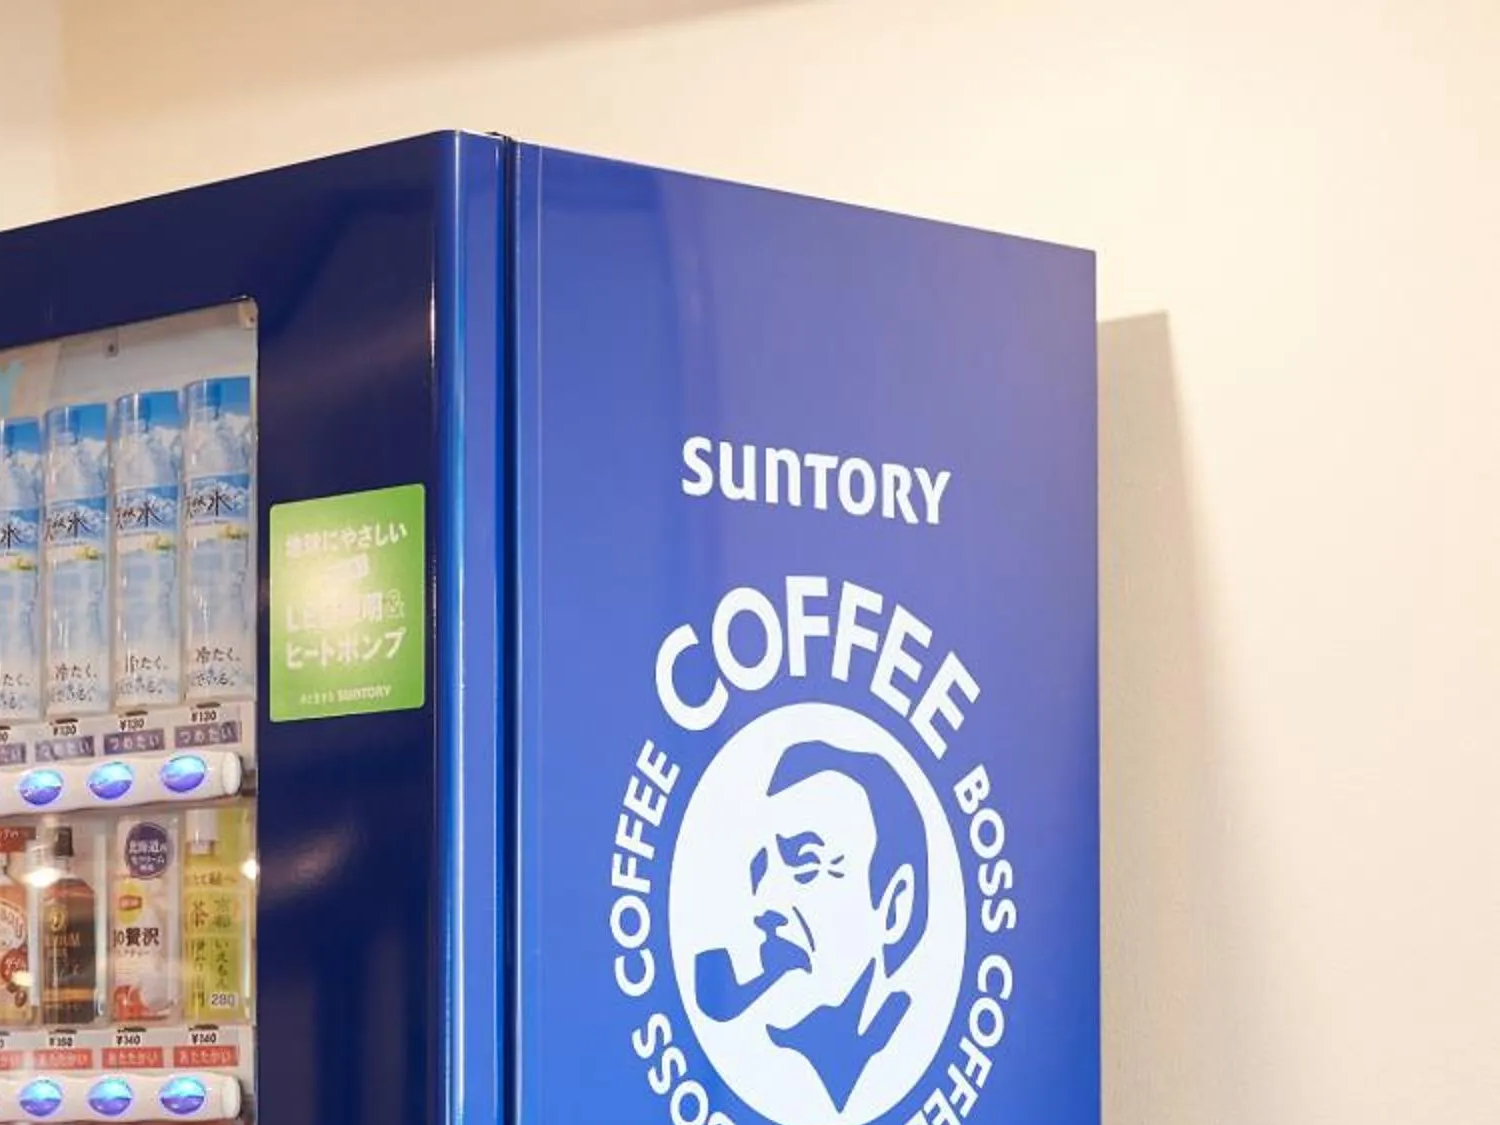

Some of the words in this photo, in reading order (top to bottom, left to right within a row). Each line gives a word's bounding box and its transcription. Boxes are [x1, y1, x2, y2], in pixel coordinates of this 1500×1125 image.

[681, 435, 952, 525] SUNTORY
[655, 575, 981, 761] COFFEE
[609, 740, 681, 997] COFFEE
[953, 764, 1017, 933] BOSS
